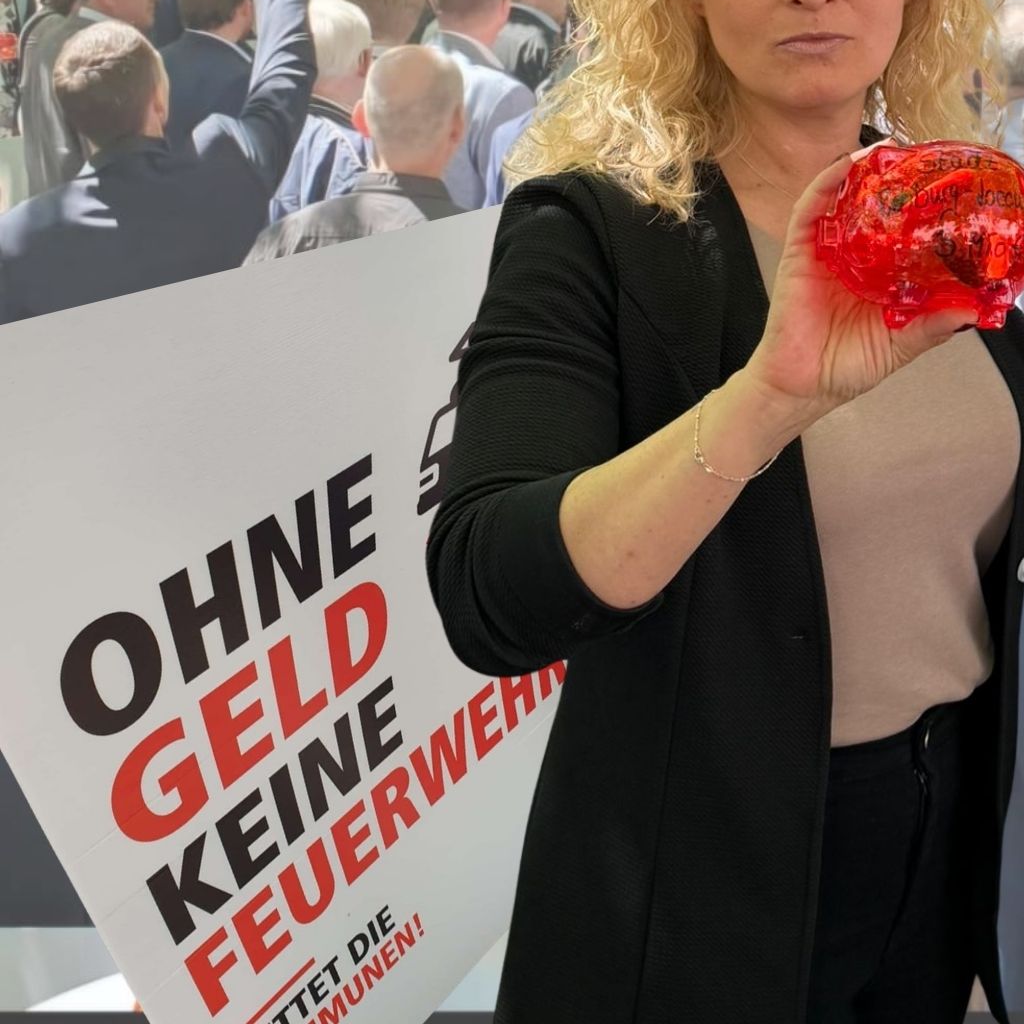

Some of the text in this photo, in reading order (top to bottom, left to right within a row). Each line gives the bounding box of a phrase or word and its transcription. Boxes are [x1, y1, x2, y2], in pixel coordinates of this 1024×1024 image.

[60, 453, 377, 736] OHNE
[110, 581, 389, 843] GELD
[146, 676, 404, 946] KEINE
[268, 904, 396, 1024] TTET DIE
[308, 912, 425, 1024] MUNEN!
